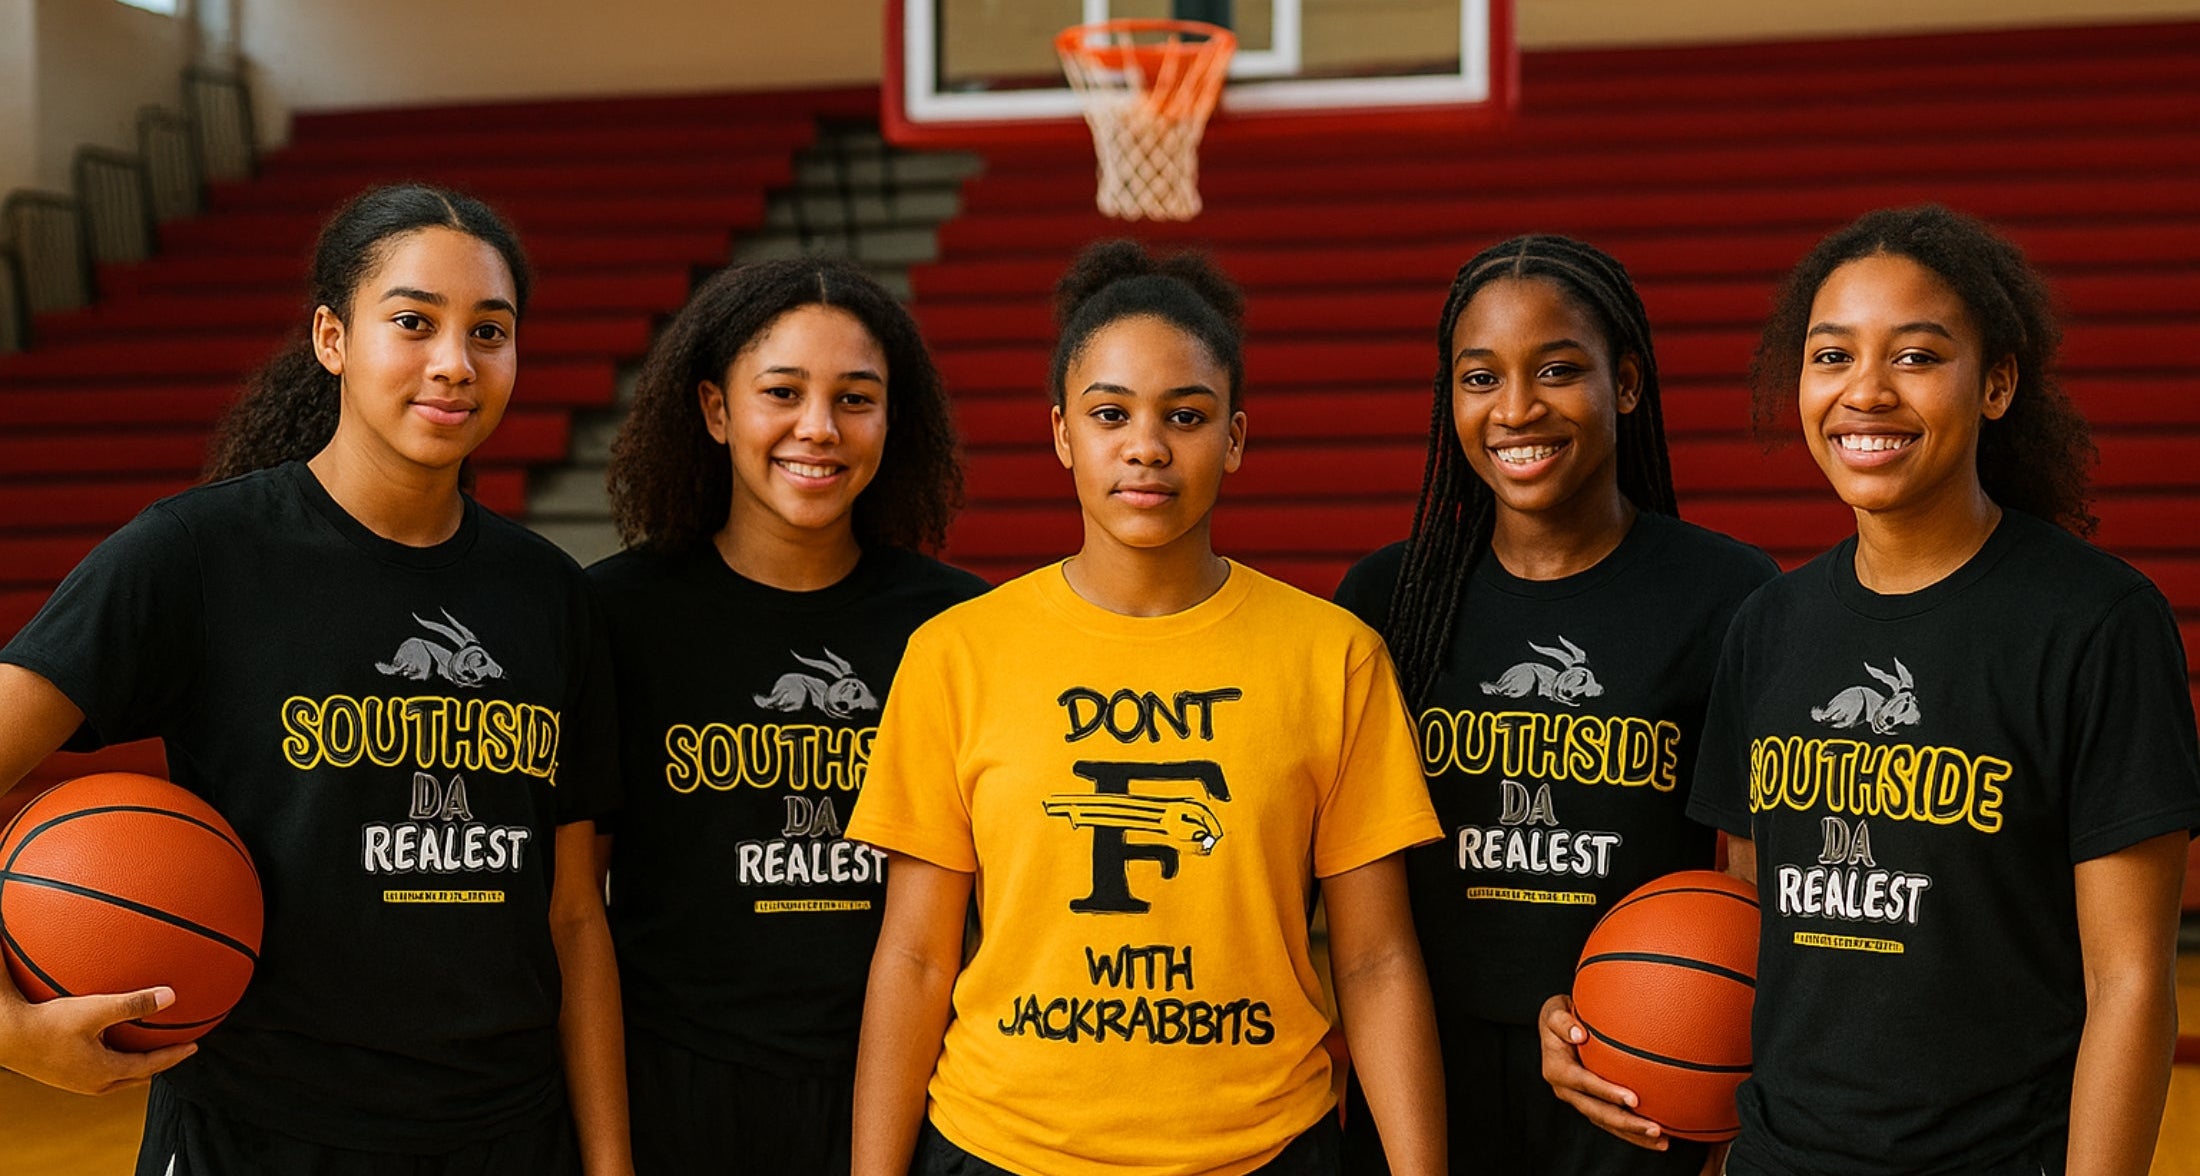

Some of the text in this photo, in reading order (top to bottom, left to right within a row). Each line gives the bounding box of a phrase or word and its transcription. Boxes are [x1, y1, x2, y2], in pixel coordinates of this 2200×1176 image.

[281, 694, 560, 787] SOUTHSID
[1057, 687, 1242, 743] DONT
[409, 771, 473, 821] DA
[782, 795, 841, 837] DA
[1499, 779, 1559, 826] DA
[362, 822, 532, 873] REALEST
[736, 839, 888, 886] REALEST
[1069, 760, 1233, 914] F
[1457, 825, 1622, 878] REALEST
[1818, 816, 1876, 867] DA
[1775, 864, 1932, 926] REALEST
[1085, 944, 1195, 991] WITH
[998, 995, 1276, 1046] JACKRABBITS
